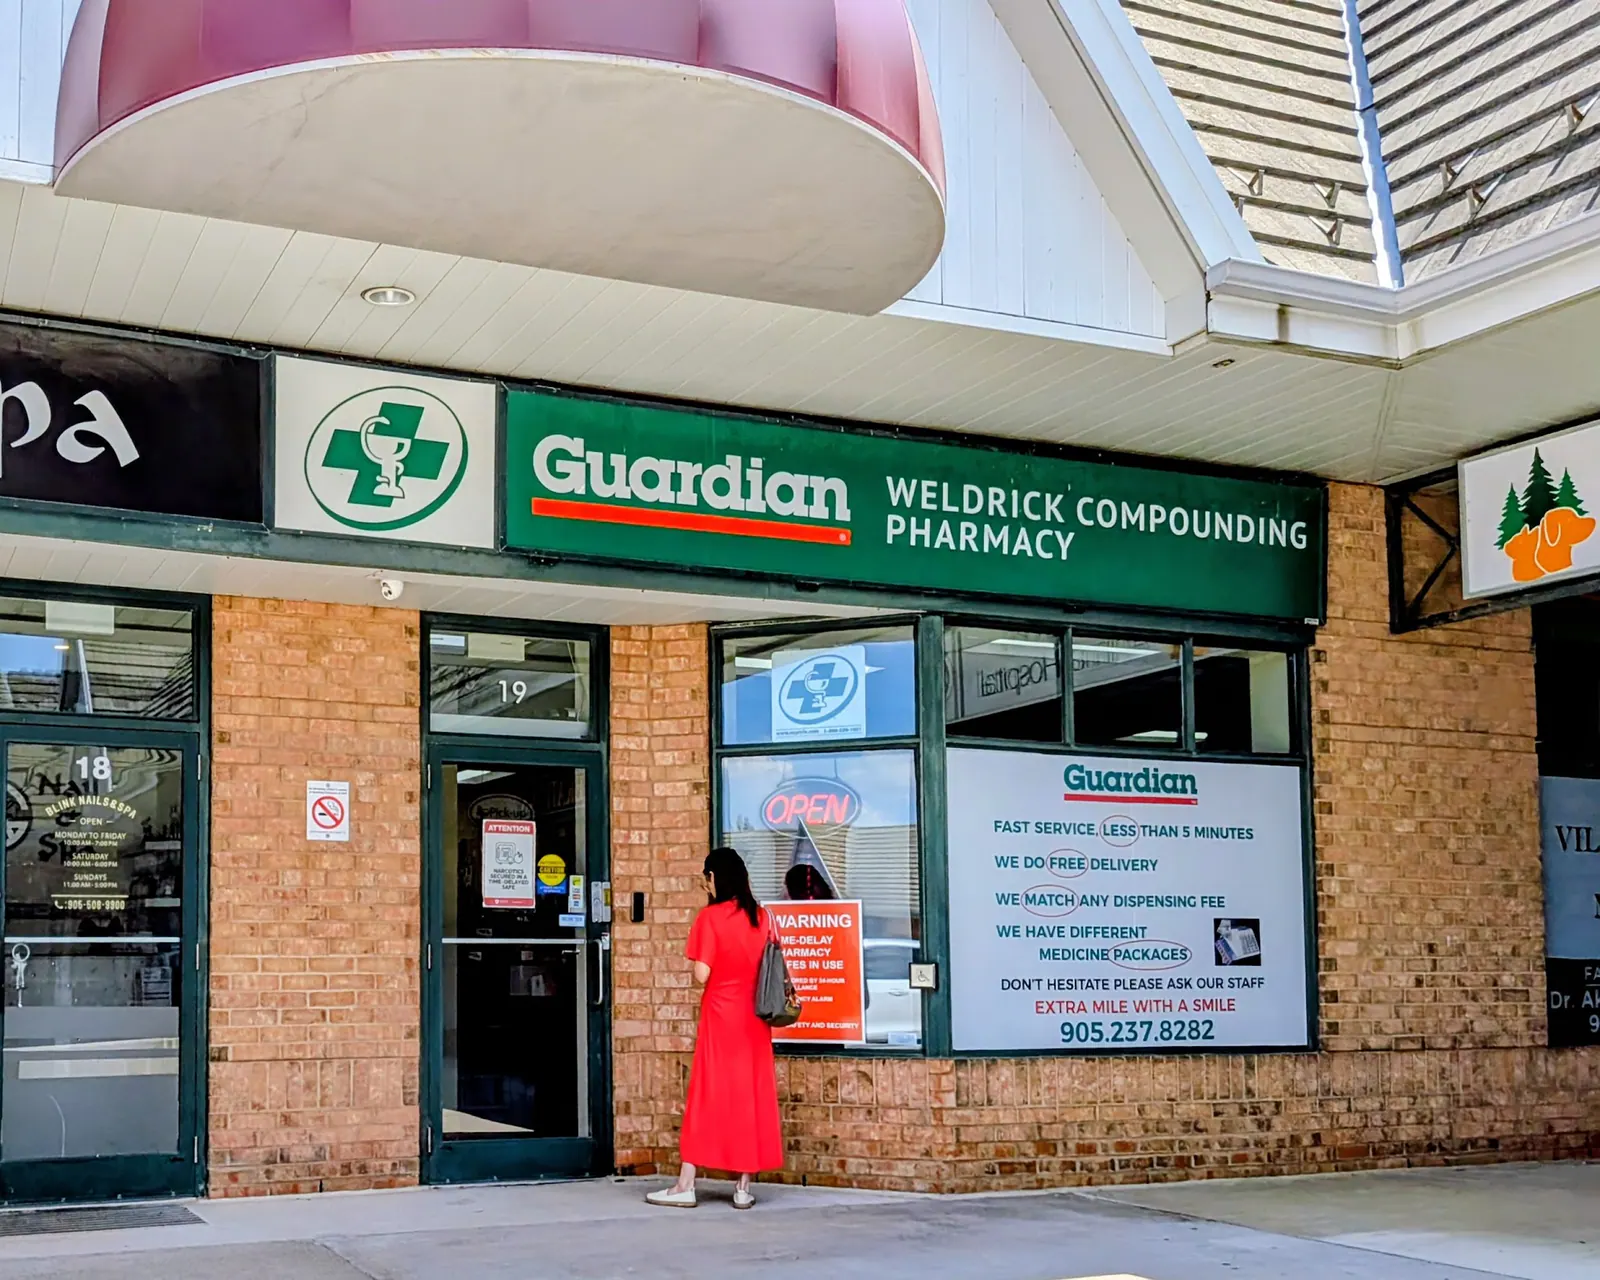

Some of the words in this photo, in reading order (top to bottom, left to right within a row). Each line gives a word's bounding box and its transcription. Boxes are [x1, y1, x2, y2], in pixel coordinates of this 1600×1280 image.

[532, 434, 850, 522] Guardian
[886, 476, 1065, 523] WELDRICK
[1076, 496, 1307, 550] COMPOUNDING
[886, 514, 1075, 560] PHARMACY
[499, 680, 527, 704] 19
[76, 756, 111, 779] 18
[1063, 763, 1198, 794] Guardian
[45, 797, 76, 817] BLINK
[764, 794, 850, 824] OPEN
[80, 817, 103, 826] OPEN
[488, 824, 530, 833] ATTENTION
[54, 831, 87, 839] MONDAY
[100, 832, 127, 840] FRIDAY
[994, 820, 1031, 834] FAST
[1034, 821, 1099, 837] SERVICE,
[1103, 824, 1136, 837] LESS
[1140, 825, 1178, 838] THAN
[1182, 826, 1190, 838] 5
[1194, 826, 1254, 840] MINUTES
[72, 852, 109, 860] SATURDAY
[995, 855, 1019, 868] WE
[1024, 856, 1045, 868] DO
[1050, 857, 1086, 870] FREE
[1090, 858, 1158, 871] DELIVERY
[996, 892, 1020, 905] WE
[1025, 893, 1075, 906] MATCH
[1080, 894, 1109, 907] ANY
[1113, 895, 1197, 907] DISPENSING
[1200, 896, 1226, 908] FEE
[781, 935, 834, 945] ME-DELAY
[996, 925, 1021, 938] WE
[1025, 925, 1066, 938] HAVE
[1070, 926, 1148, 939] DIFFERENT
[1039, 948, 1109, 961] MEDICINE
[1113, 948, 1189, 961] PACKAGES
[786, 960, 807, 970] FES
[809, 960, 820, 970] IN
[822, 960, 844, 970] USE
[1001, 979, 1044, 991] DON'T
[1047, 979, 1110, 991] HESITATE
[1114, 978, 1163, 991] PLEASE
[1166, 978, 1193, 990] ASK
[1196, 977, 1225, 990] OUR
[1227, 977, 1265, 990] STAFF
[1035, 1001, 1088, 1014] EXTRA
[1092, 1000, 1129, 1014] MILE
[1133, 1000, 1173, 1013] WITH
[1178, 999, 1188, 1012] A
[1192, 998, 1236, 1012] SMILE
[1550, 991, 1575, 1009] Dr.
[1060, 1019, 1215, 1043] 905.237.8282
